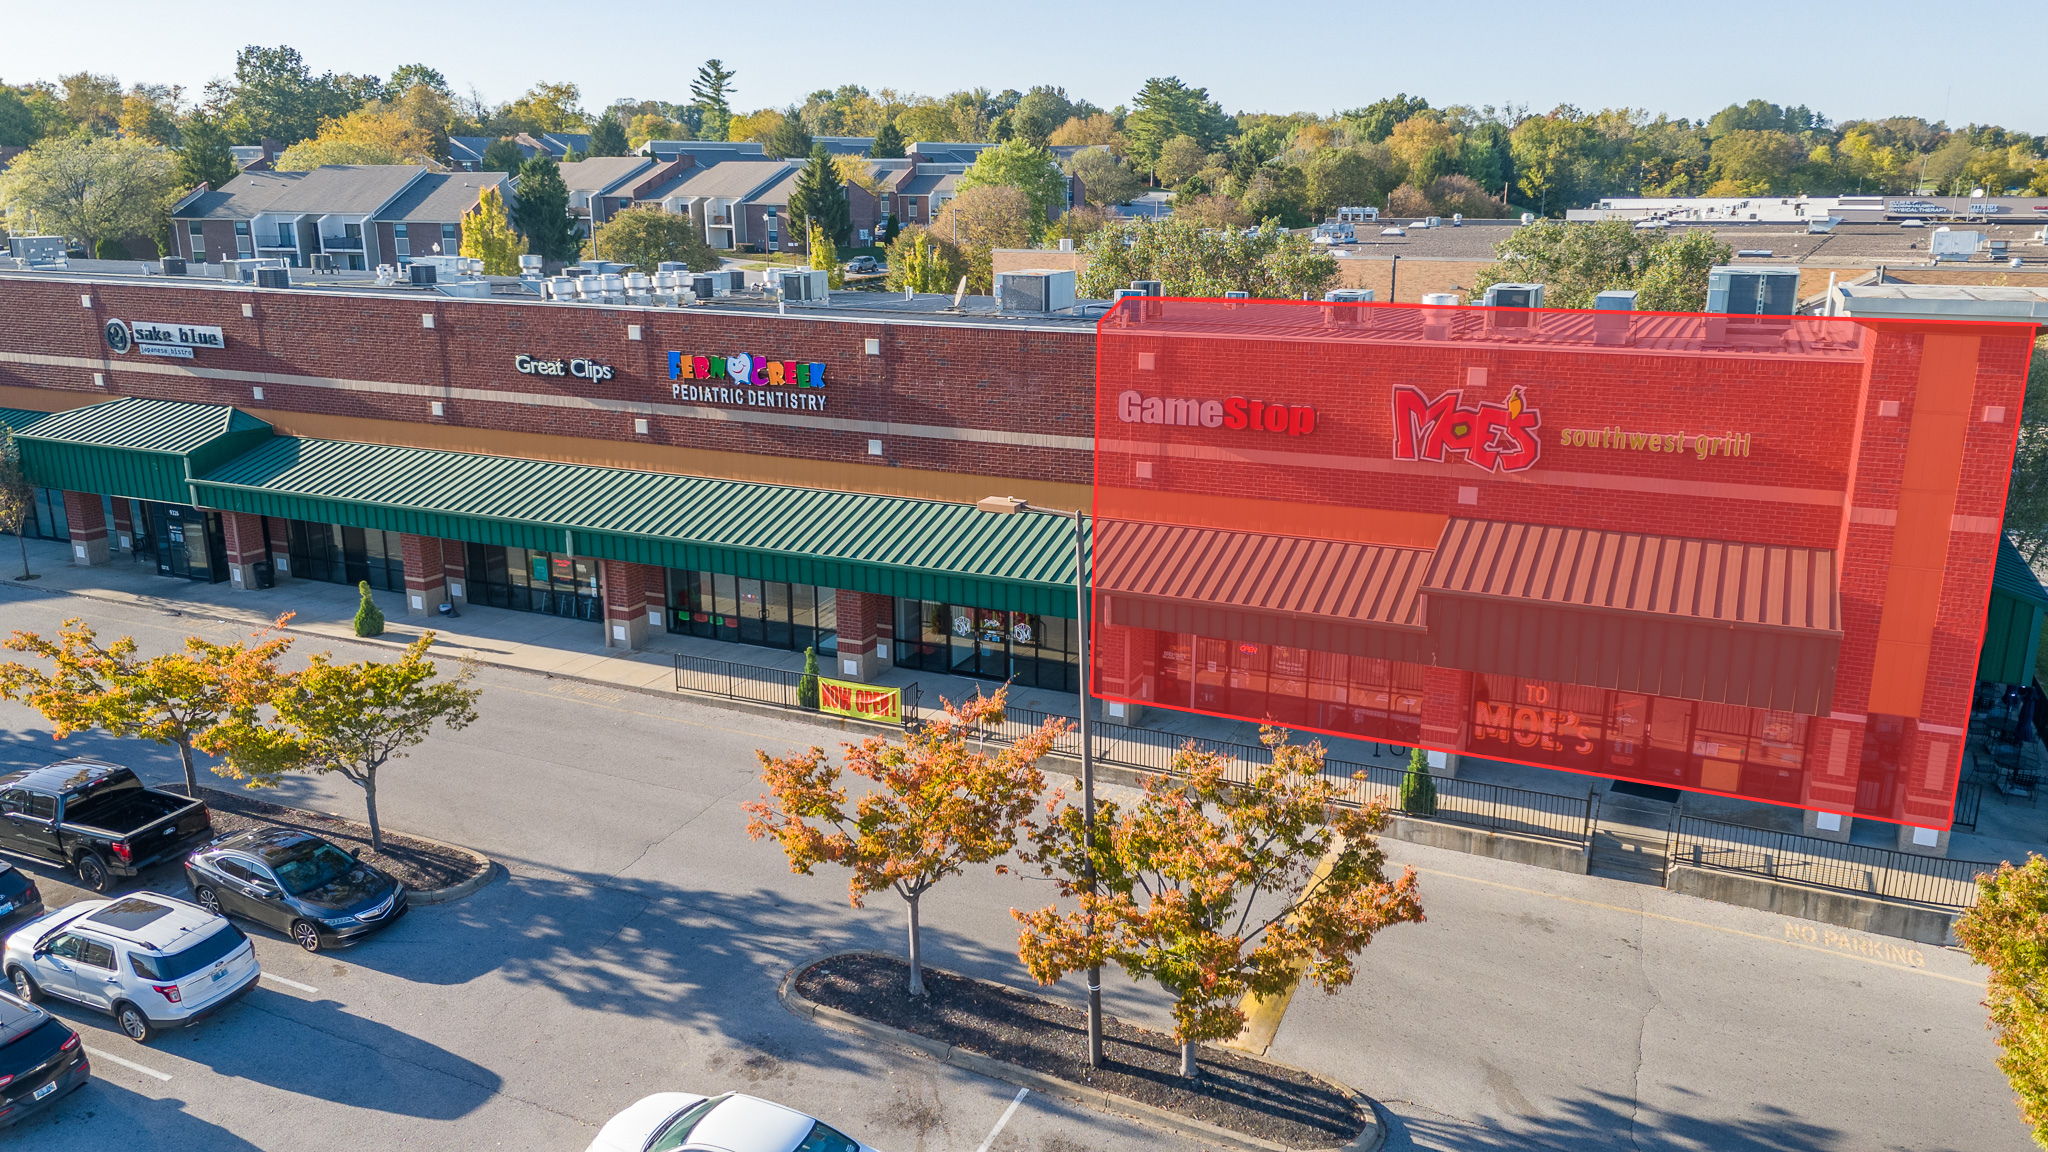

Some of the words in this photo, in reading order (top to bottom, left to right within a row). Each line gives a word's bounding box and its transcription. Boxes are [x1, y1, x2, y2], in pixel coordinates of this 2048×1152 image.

[135, 326, 173, 342] sake
[178, 327, 219, 346] blue
[141, 345, 168, 354] japanese
[170, 347, 192, 356] bistro
[515, 354, 566, 376] Great
[570, 358, 613, 383] Clips
[667, 351, 727, 380] FERN
[751, 356, 826, 389] CREEK
[672, 384, 744, 405] PEDIATRIC
[748, 390, 826, 411] DENTISTRY
[1118, 389, 1316, 436] GameStop
[1561, 426, 1685, 453] southwest
[1694, 431, 1751, 460] grill
[1240, 644, 1258, 654] OPEN
[821, 683, 852, 711] NOW
[855, 689, 897, 717] OPEN!
[1525, 684, 1550, 705] TO
[1785, 921, 1818, 943] NO
[1823, 929, 1926, 968] PARKING
